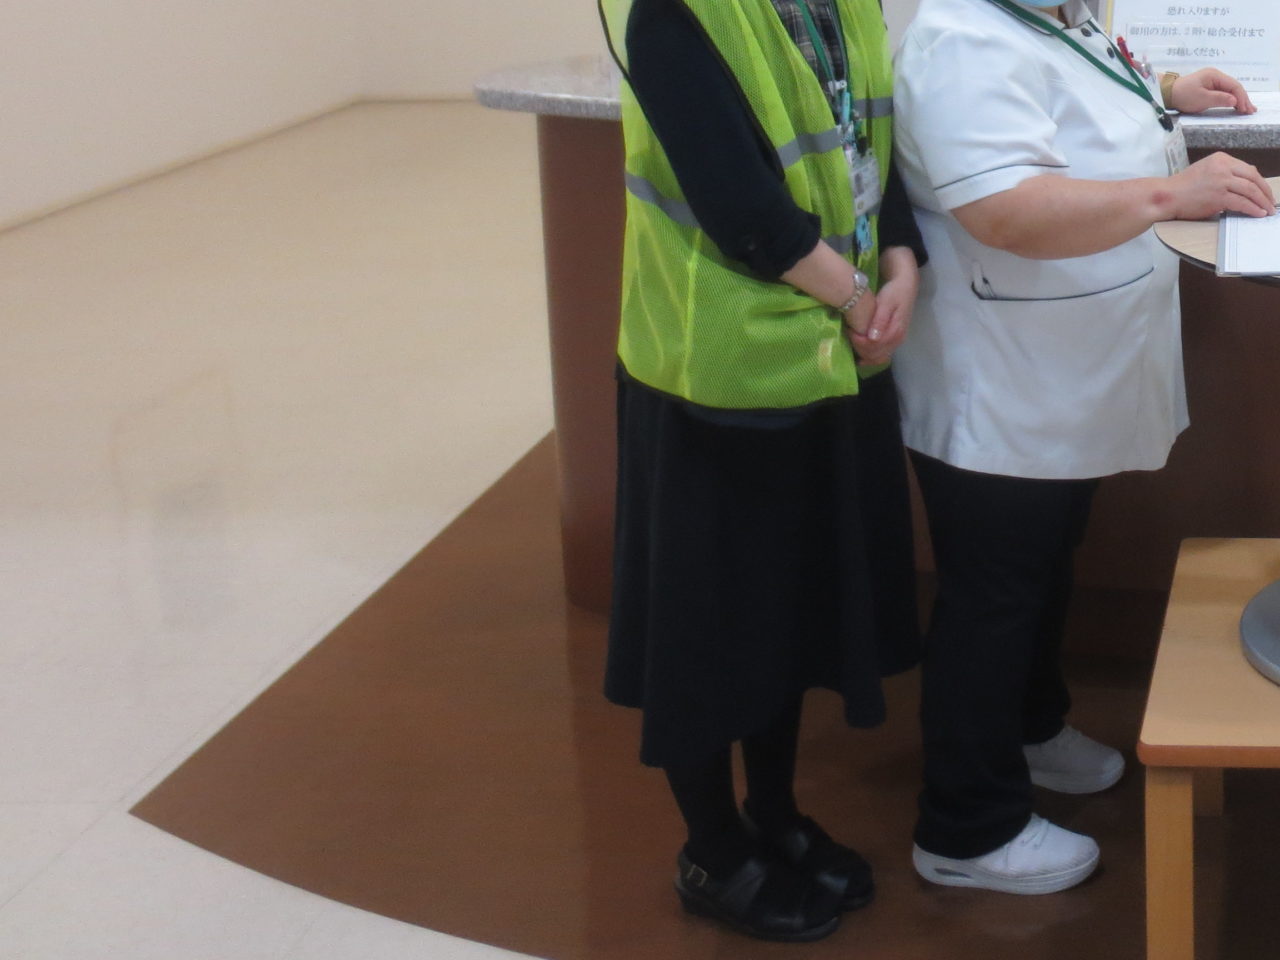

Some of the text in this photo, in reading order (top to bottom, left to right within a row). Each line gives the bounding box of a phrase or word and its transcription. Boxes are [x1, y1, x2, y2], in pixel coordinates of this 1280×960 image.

[1167, 6, 1230, 16] 恐れ入りますが
